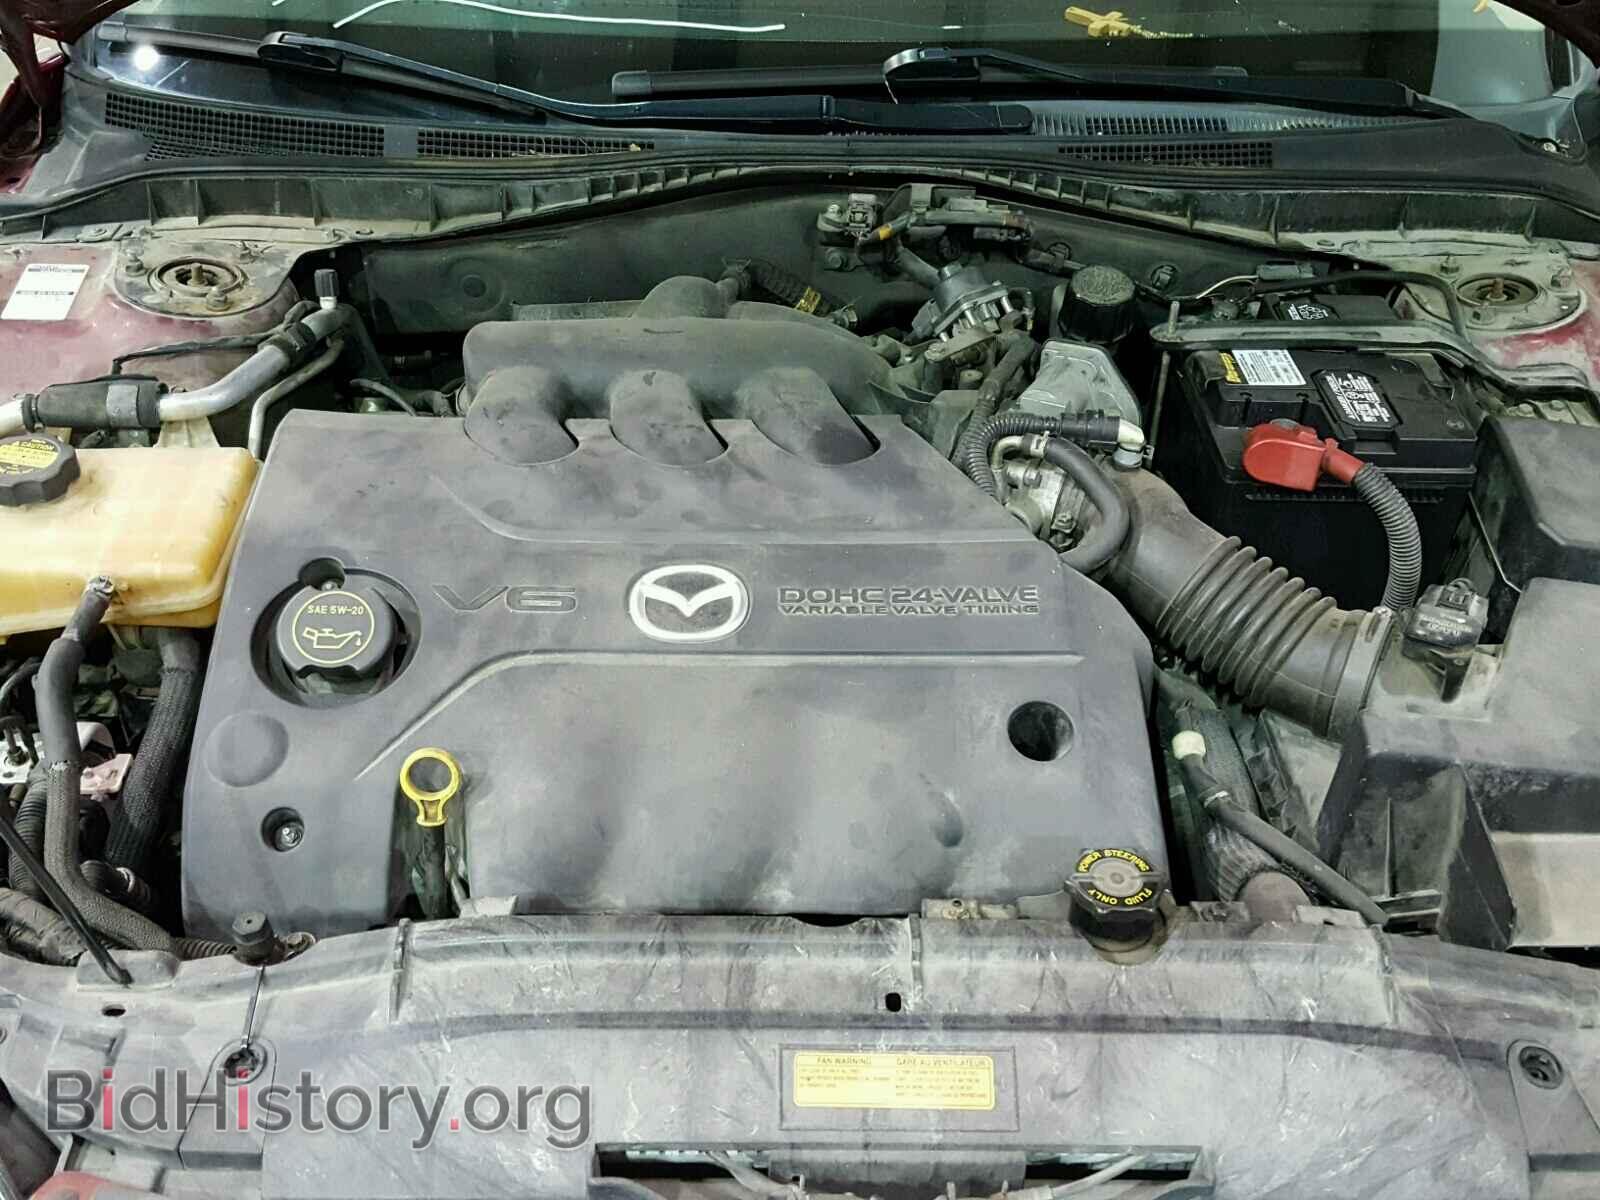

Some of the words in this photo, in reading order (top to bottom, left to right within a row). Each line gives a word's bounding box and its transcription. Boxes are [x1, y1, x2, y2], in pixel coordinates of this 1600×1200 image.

[778, 587, 885, 604] DOHC
[889, 586, 1040, 604] 24-VALVE
[307, 605, 328, 615] SAE
[330, 605, 365, 616] 5W-20
[778, 605, 887, 615] VARIABLE
[891, 605, 956, 615] VALVE
[962, 604, 1039, 615] TIMING
[1077, 851, 1102, 873] POWER
[1103, 849, 1150, 873] STEERING
[1087, 888, 1118, 905] ONLY
[1124, 888, 1153, 906] FLUID
[816, 1056, 833, 1065] FAN
